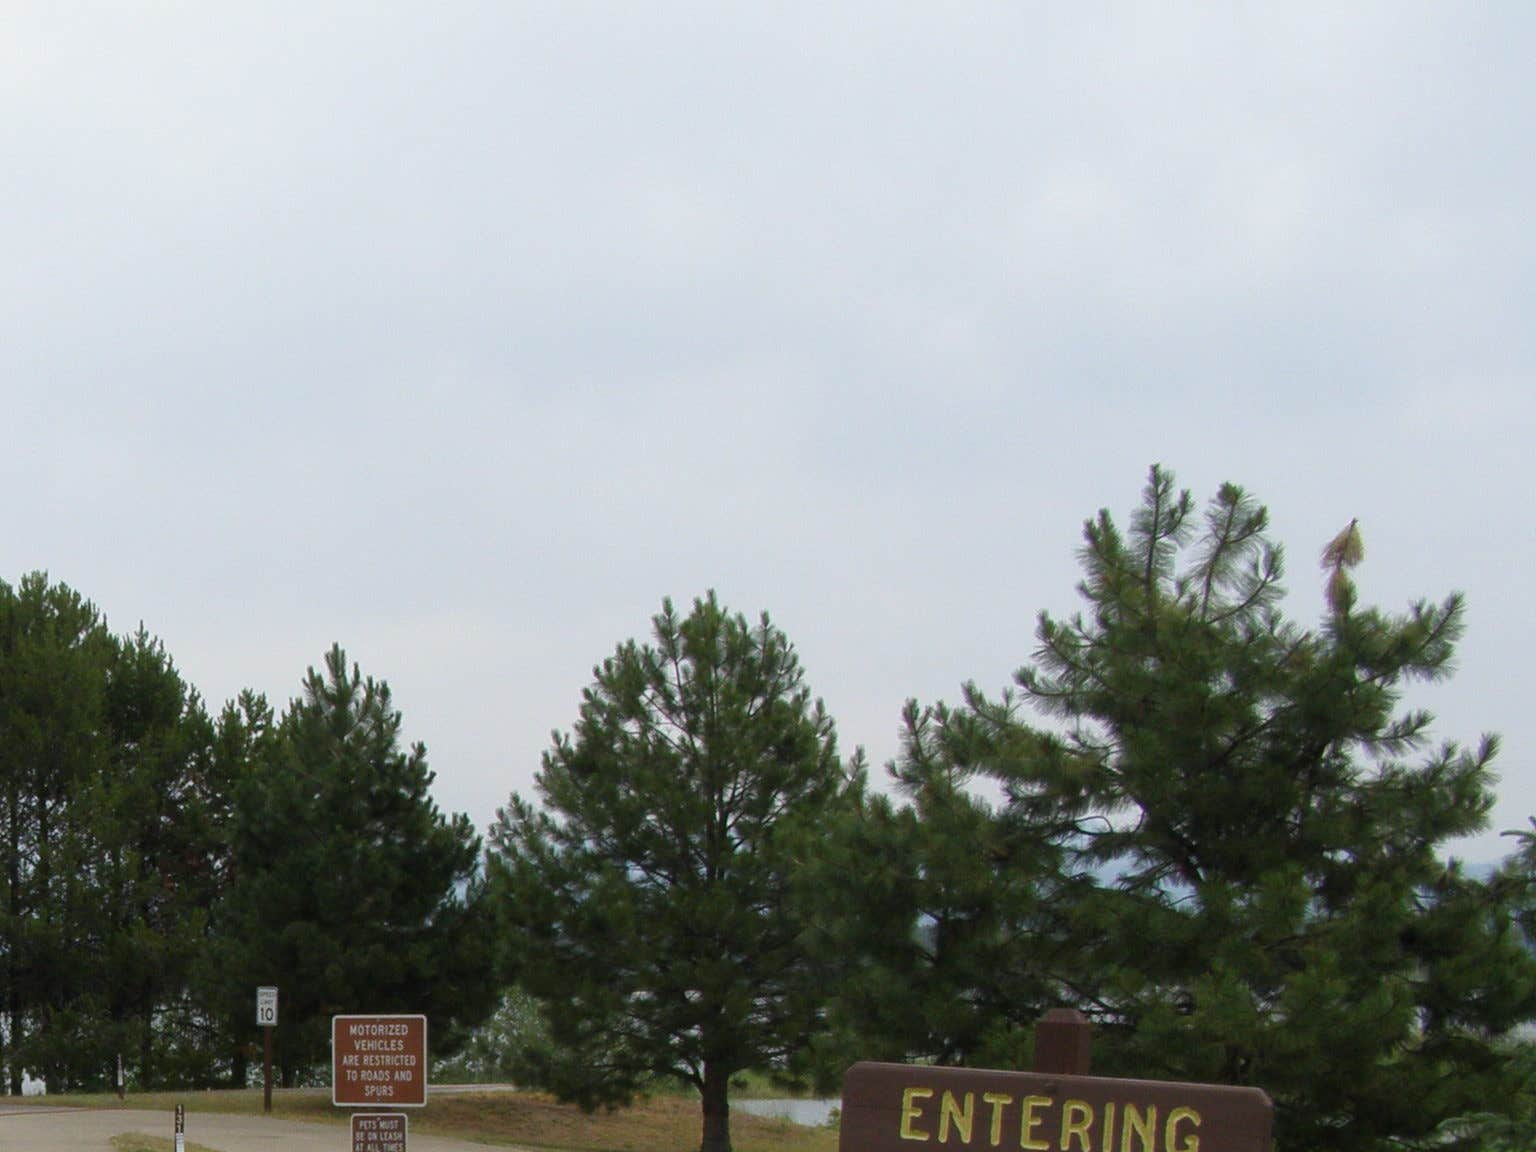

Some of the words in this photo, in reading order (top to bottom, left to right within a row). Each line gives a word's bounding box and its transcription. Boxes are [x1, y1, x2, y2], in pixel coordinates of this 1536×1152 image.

[260, 1007, 274, 1021] 10
[349, 1024, 409, 1036] MOTORIZED
[354, 1040, 404, 1051] VEHICLES
[342, 1055, 360, 1066] ARE
[363, 1055, 417, 1066] RESTRICTED
[346, 1070, 358, 1081] TO
[360, 1070, 391, 1081] ROADS
[394, 1070, 413, 1081] AND
[364, 1085, 394, 1097] SPURS
[359, 1120, 377, 1129] PETS
[379, 1120, 399, 1129] MUST
[355, 1131, 364, 1141] BE
[367, 1131, 378, 1141] ON
[380, 1131, 403, 1141] LEASH
[355, 1143, 364, 1152] AT
[367, 1143, 379, 1152] ALL
[383, 1143, 404, 1152] TIMES
